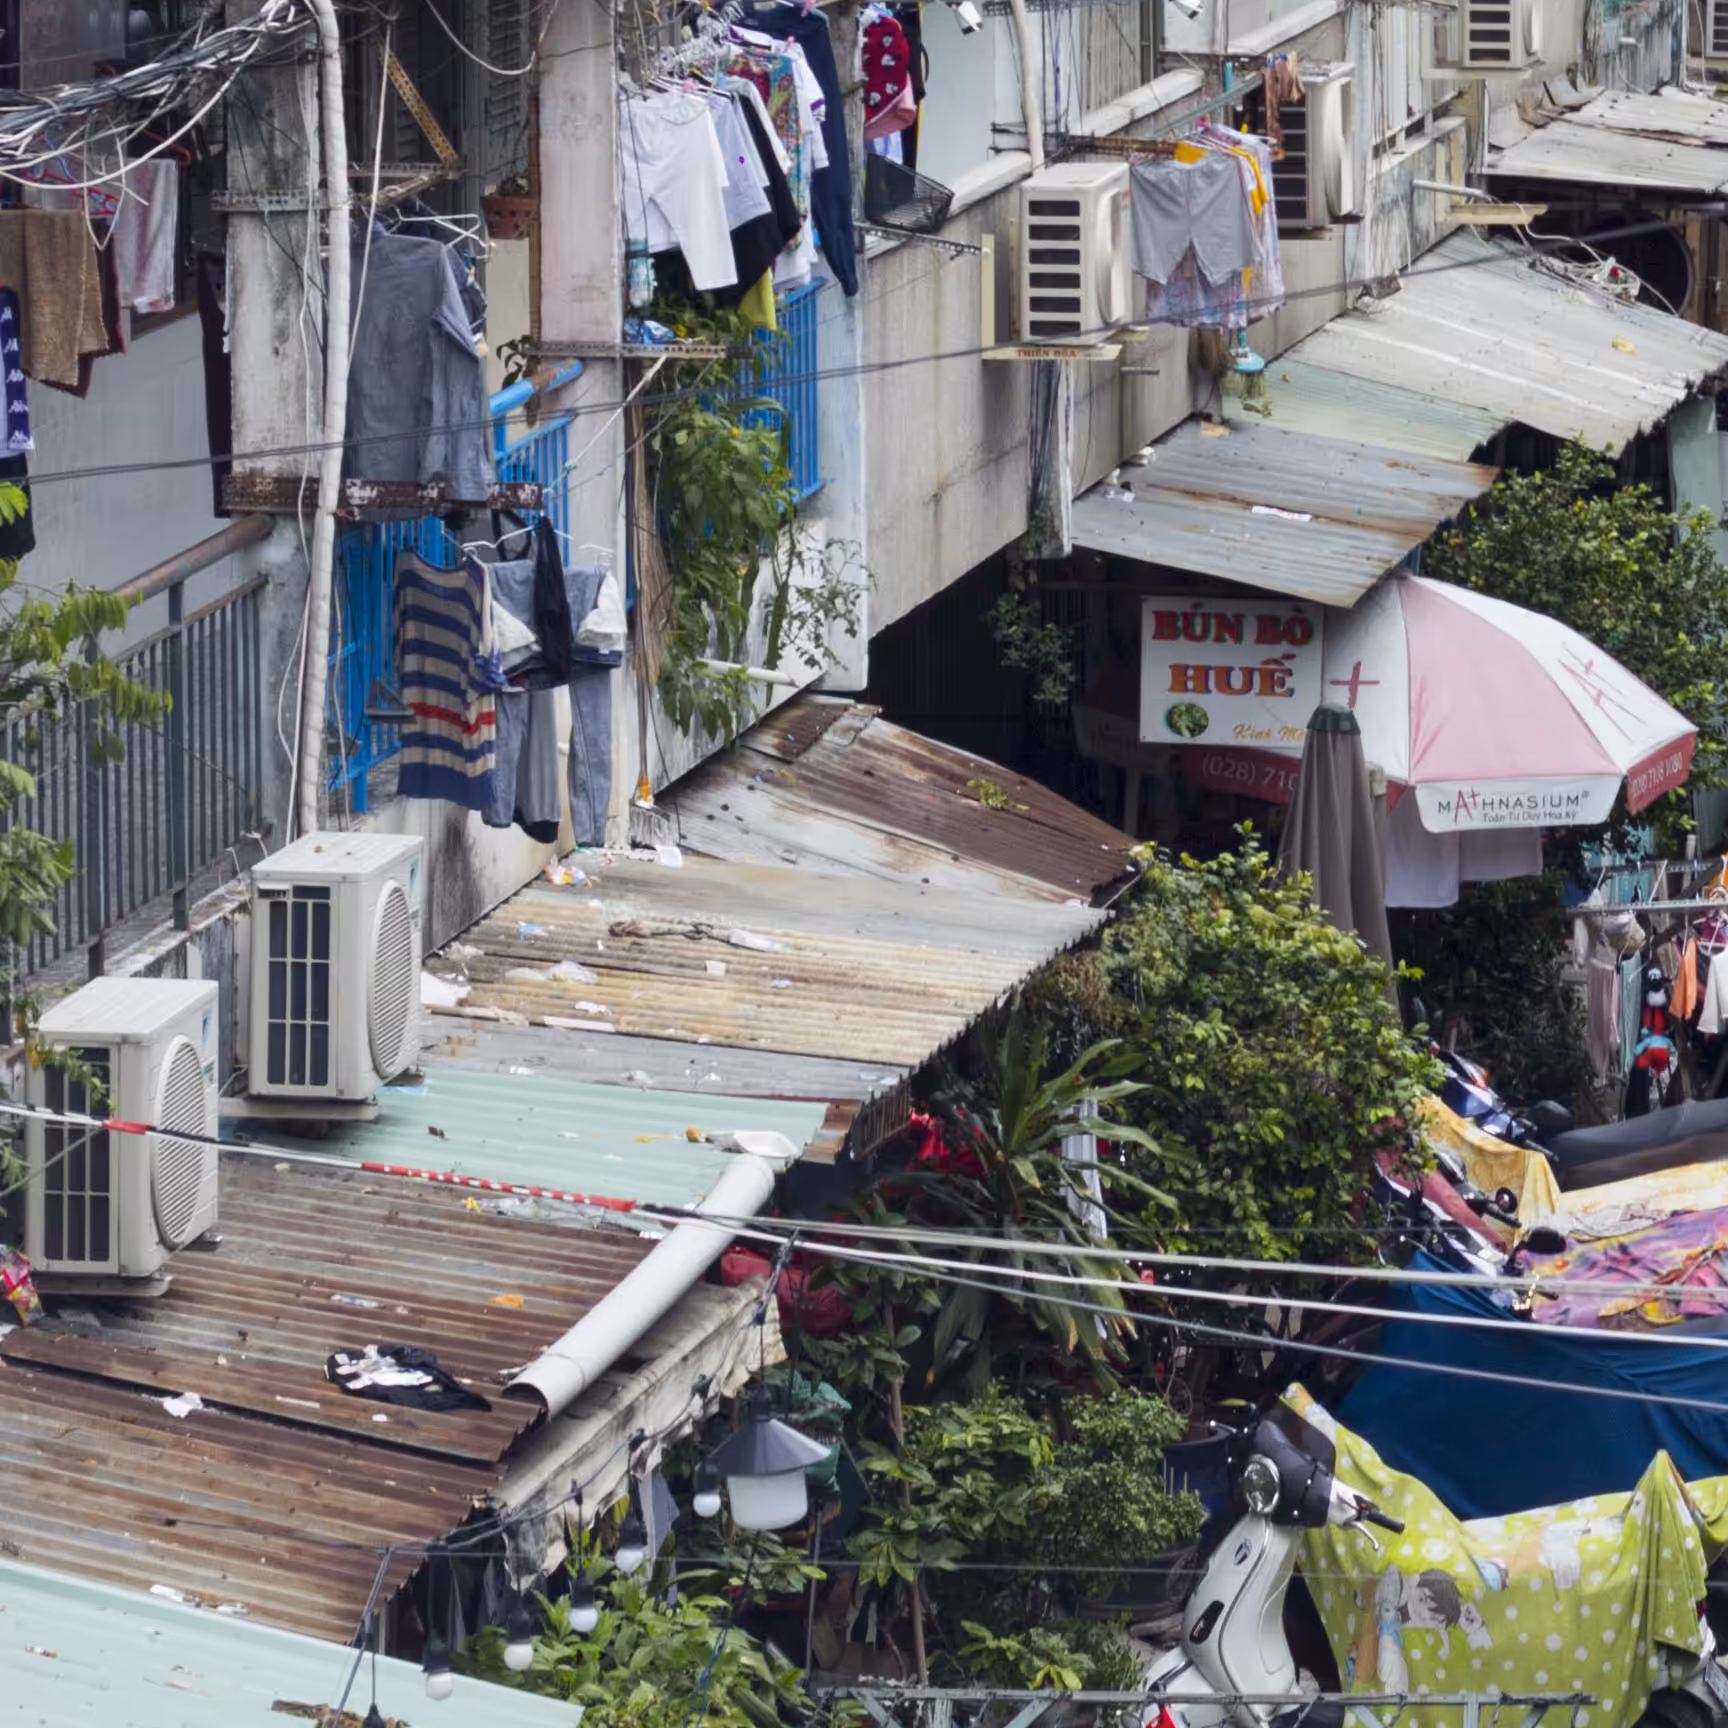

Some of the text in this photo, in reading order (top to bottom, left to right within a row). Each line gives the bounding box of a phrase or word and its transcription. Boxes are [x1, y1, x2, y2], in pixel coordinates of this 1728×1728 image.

[1152, 602, 1315, 647] BÚN BÒ
[1168, 653, 1296, 698] HUẾ
